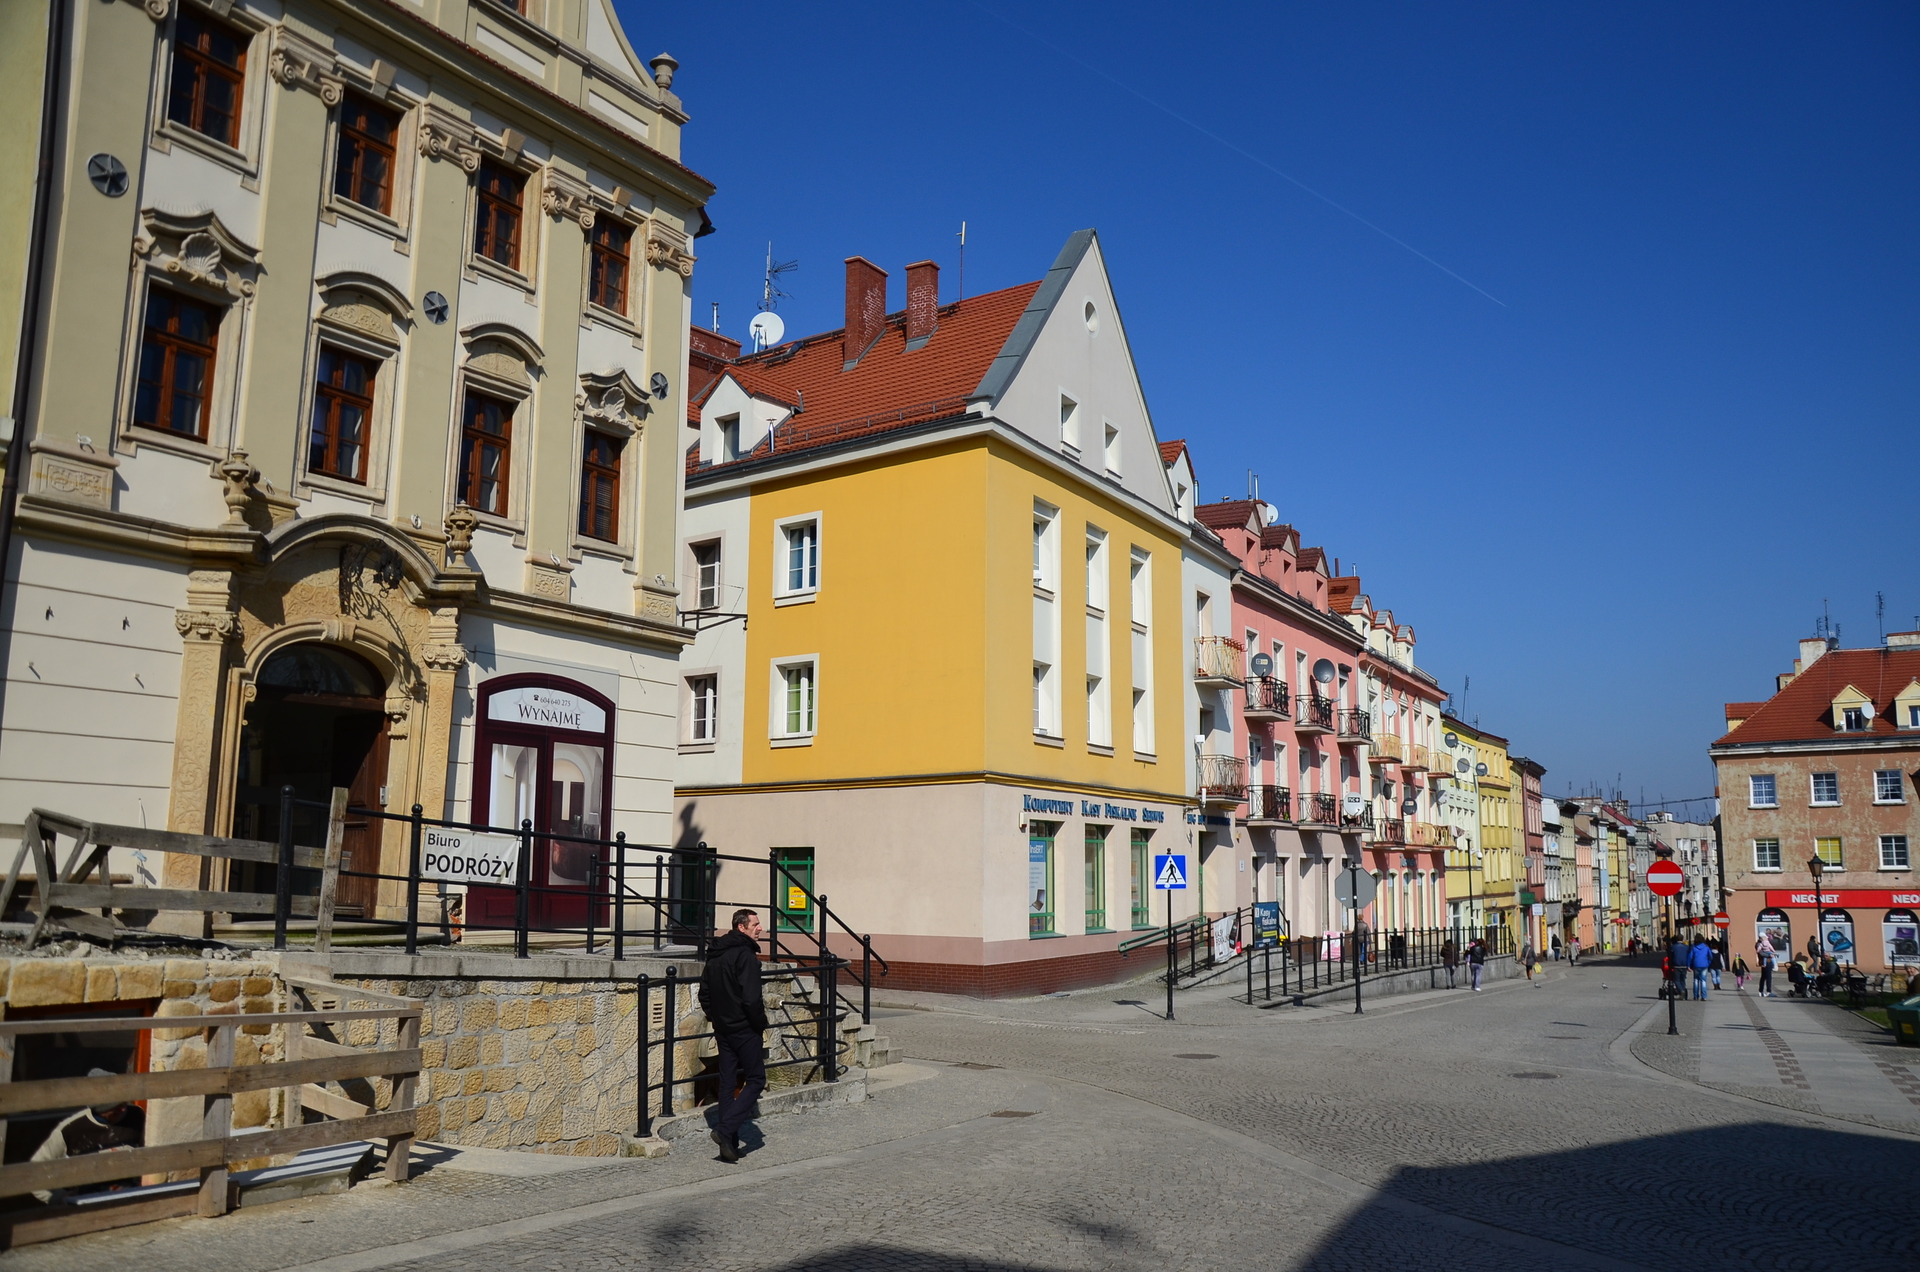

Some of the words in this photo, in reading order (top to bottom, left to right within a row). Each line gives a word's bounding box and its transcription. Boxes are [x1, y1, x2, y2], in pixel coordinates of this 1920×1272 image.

[518, 704, 580, 729] WYNAJMĘ
[427, 833, 461, 848] Biuro
[425, 853, 514, 878] PODRÓŻY
[1892, 894, 1920, 904] NEO
